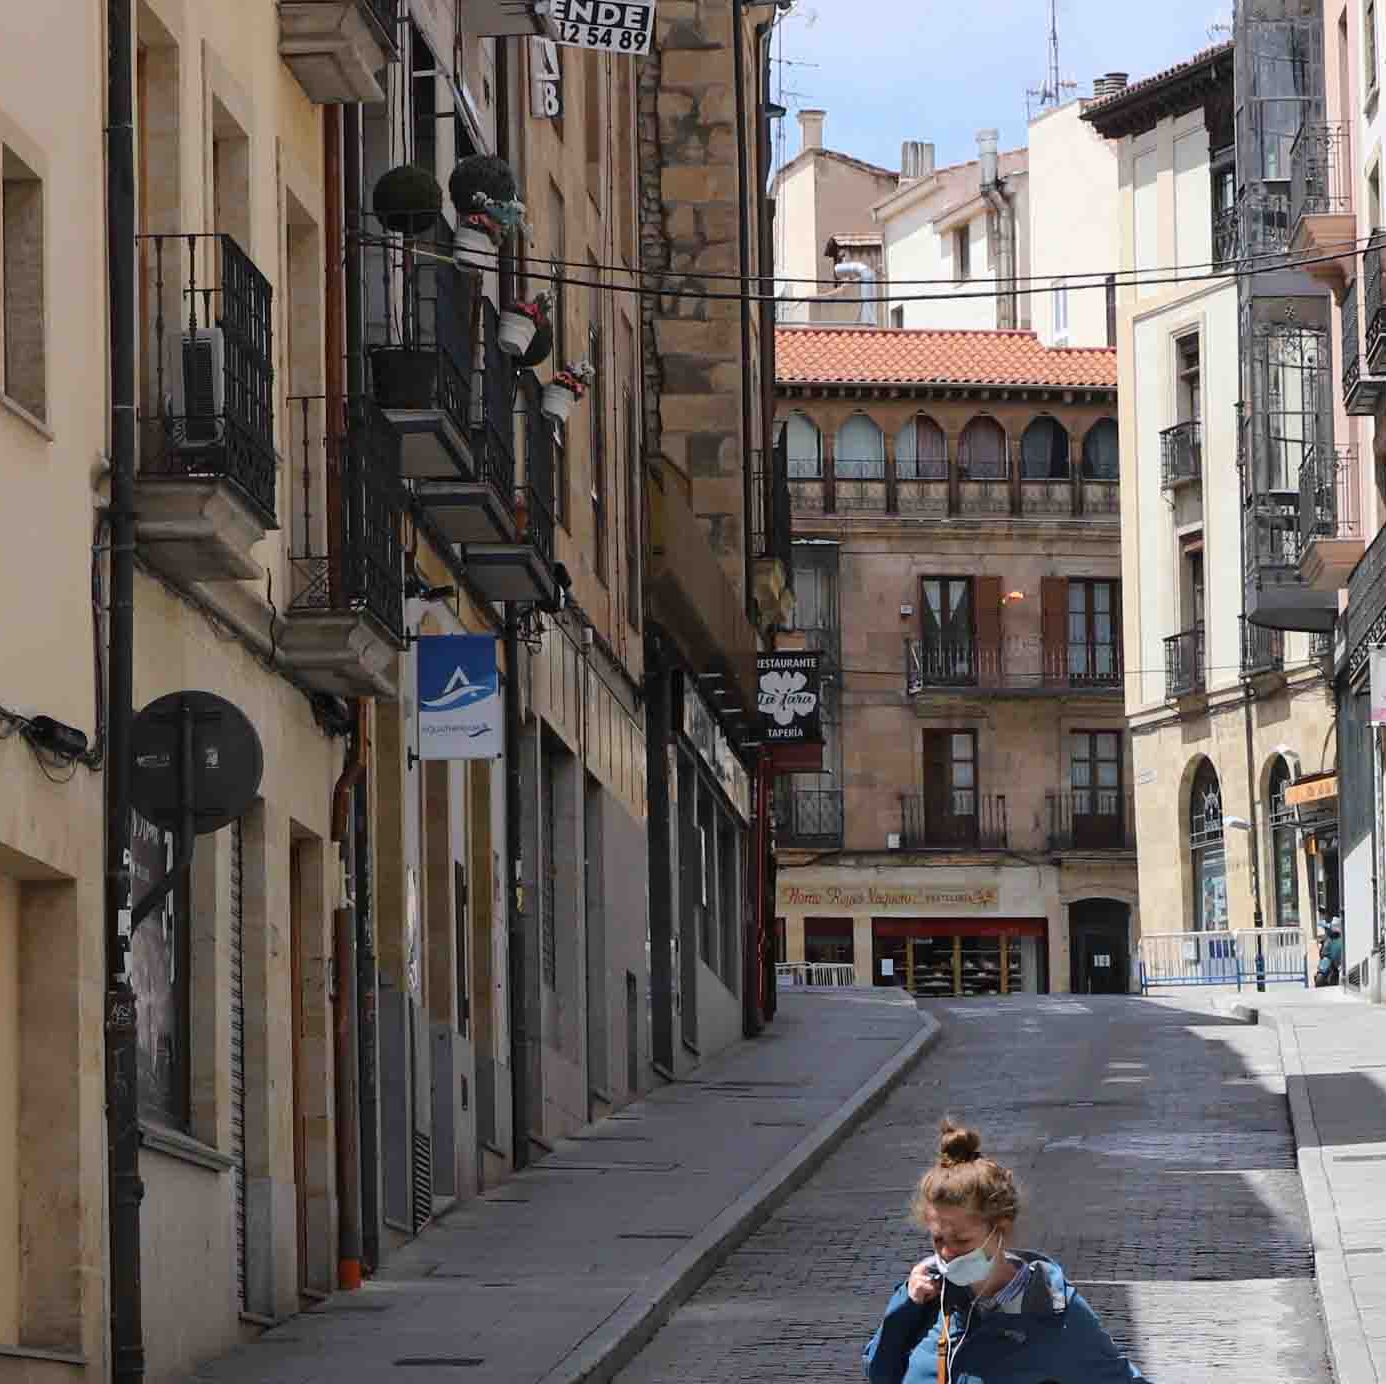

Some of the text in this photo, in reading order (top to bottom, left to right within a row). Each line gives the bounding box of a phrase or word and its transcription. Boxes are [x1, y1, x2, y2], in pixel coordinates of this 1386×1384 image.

[551, 0, 644, 28] ENDE
[587, 27, 612, 47] 54
[619, 31, 647, 51] 89
